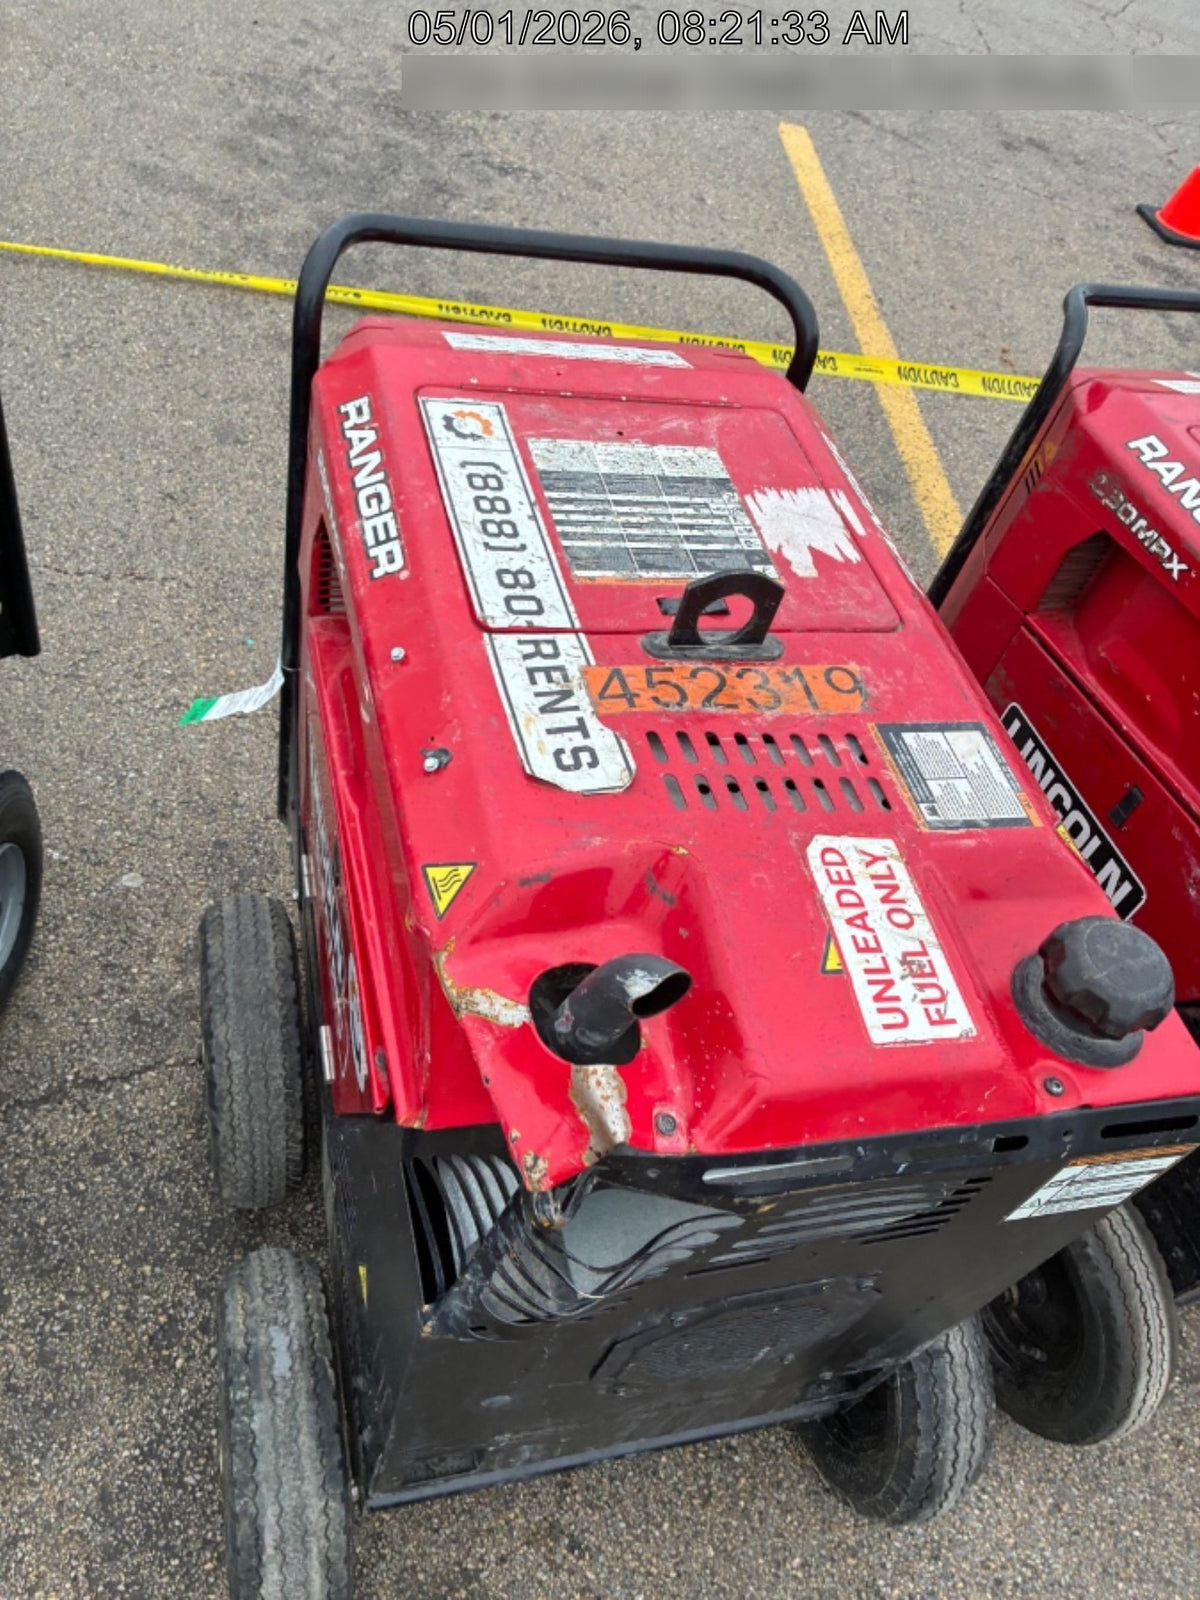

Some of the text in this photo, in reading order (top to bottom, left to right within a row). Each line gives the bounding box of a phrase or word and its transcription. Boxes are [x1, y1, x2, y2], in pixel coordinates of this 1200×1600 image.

[897, 365, 960, 388] CAUTION
[339, 395, 405, 580] RANGER
[459, 459, 527, 553] (888)
[1127, 433, 1200, 526] RAN
[597, 665, 870, 712] 452319
[820, 847, 909, 1031] UNLEADED
[859, 848, 958, 1027] FUEL ONLY
